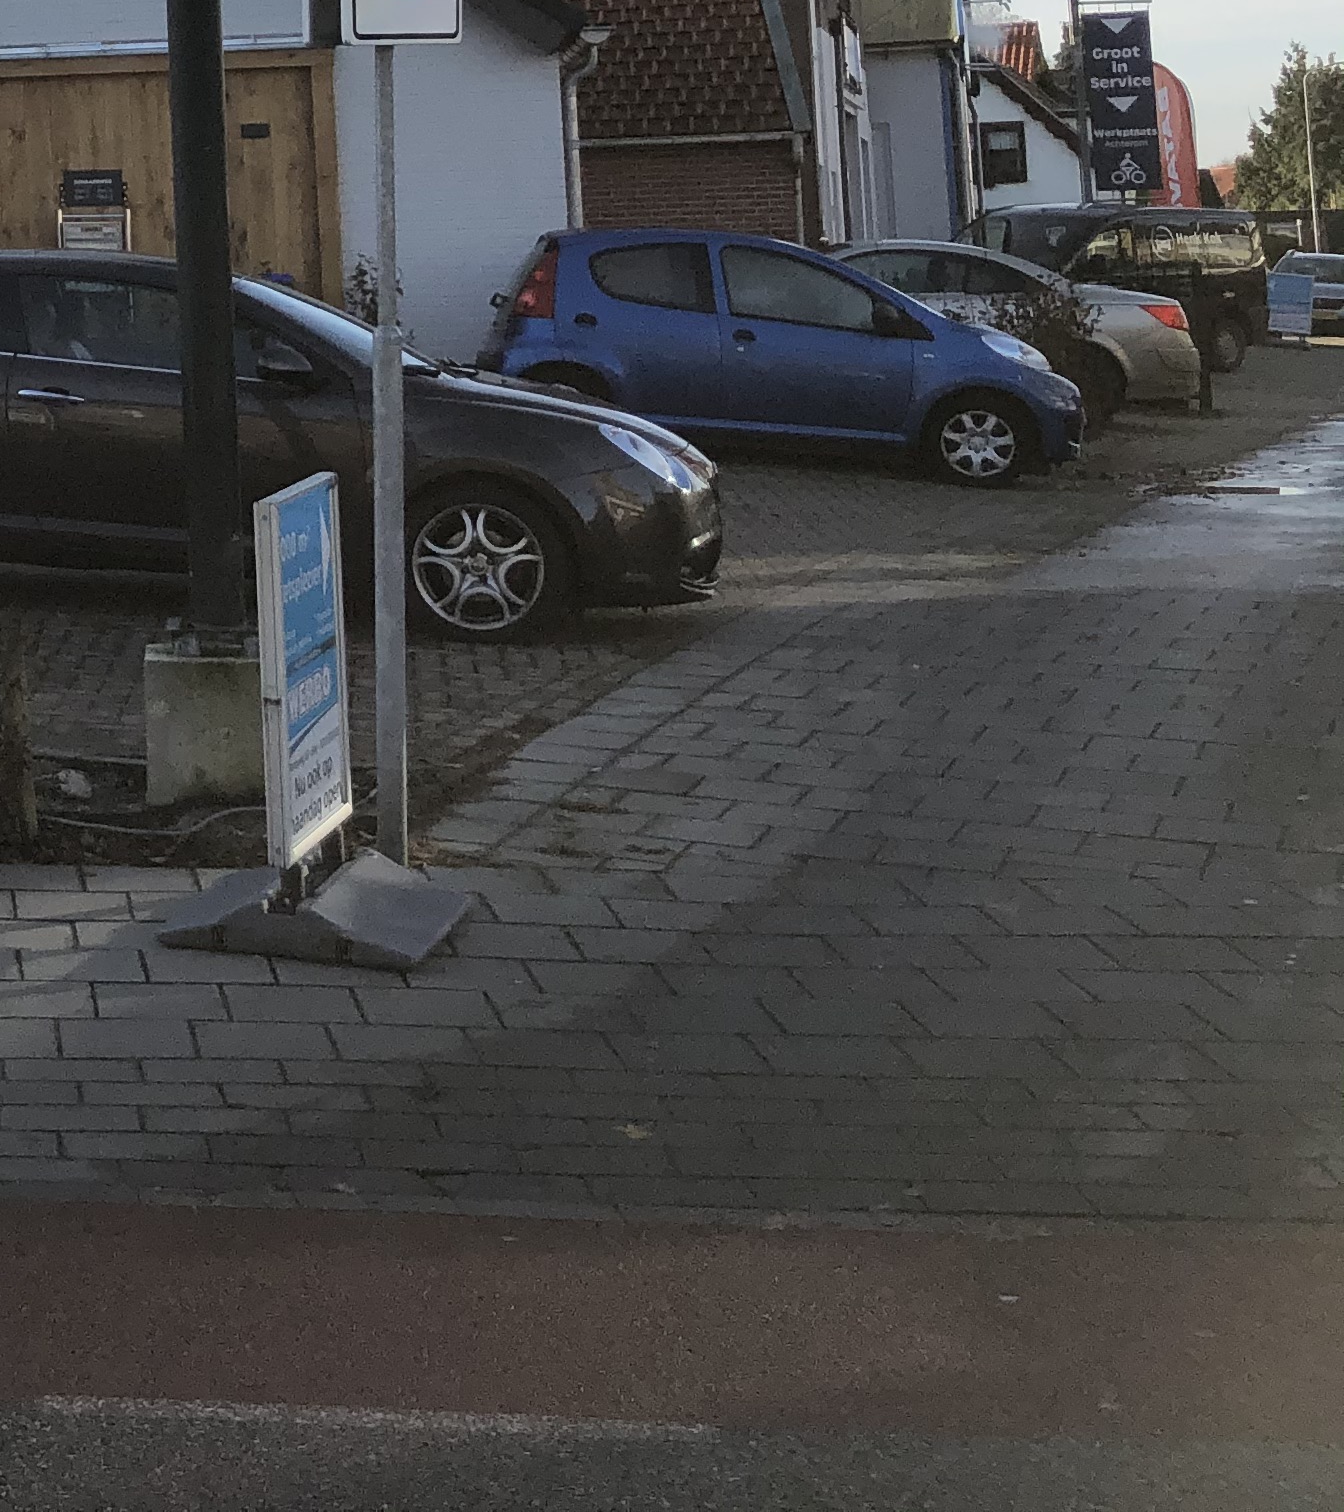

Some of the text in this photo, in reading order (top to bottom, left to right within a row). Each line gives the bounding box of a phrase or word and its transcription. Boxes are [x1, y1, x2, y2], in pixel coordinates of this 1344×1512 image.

[1092, 46, 1141, 60] Groot
[1090, 75, 1152, 89] Service
[1093, 128, 1158, 138] Werkplaats
[287, 665, 331, 723] WERBO
[295, 776, 306, 800] Nu
[307, 760, 322, 789] ook
